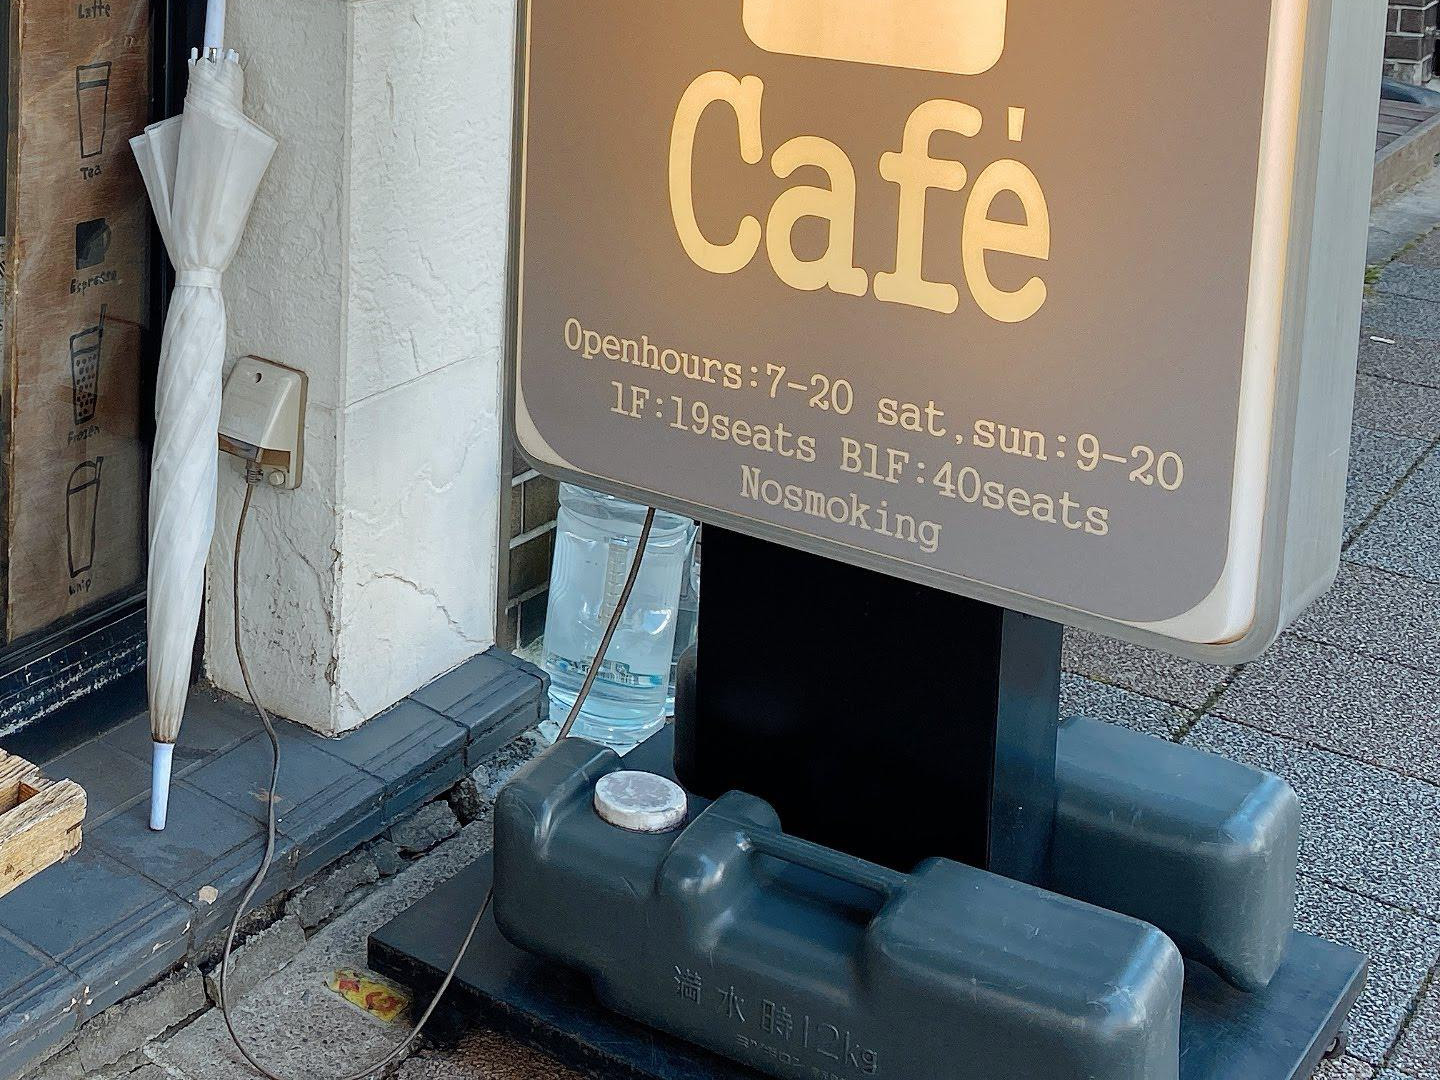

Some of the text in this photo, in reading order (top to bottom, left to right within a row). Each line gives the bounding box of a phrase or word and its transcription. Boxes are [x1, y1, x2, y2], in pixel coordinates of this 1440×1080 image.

[79, 165, 103, 180] Tea
[563, 317, 855, 416] Openhours:7-20
[610, 380, 1111, 538] 1F:19seats B1F:40seats
[740, 464, 945, 555] Nosmoking
